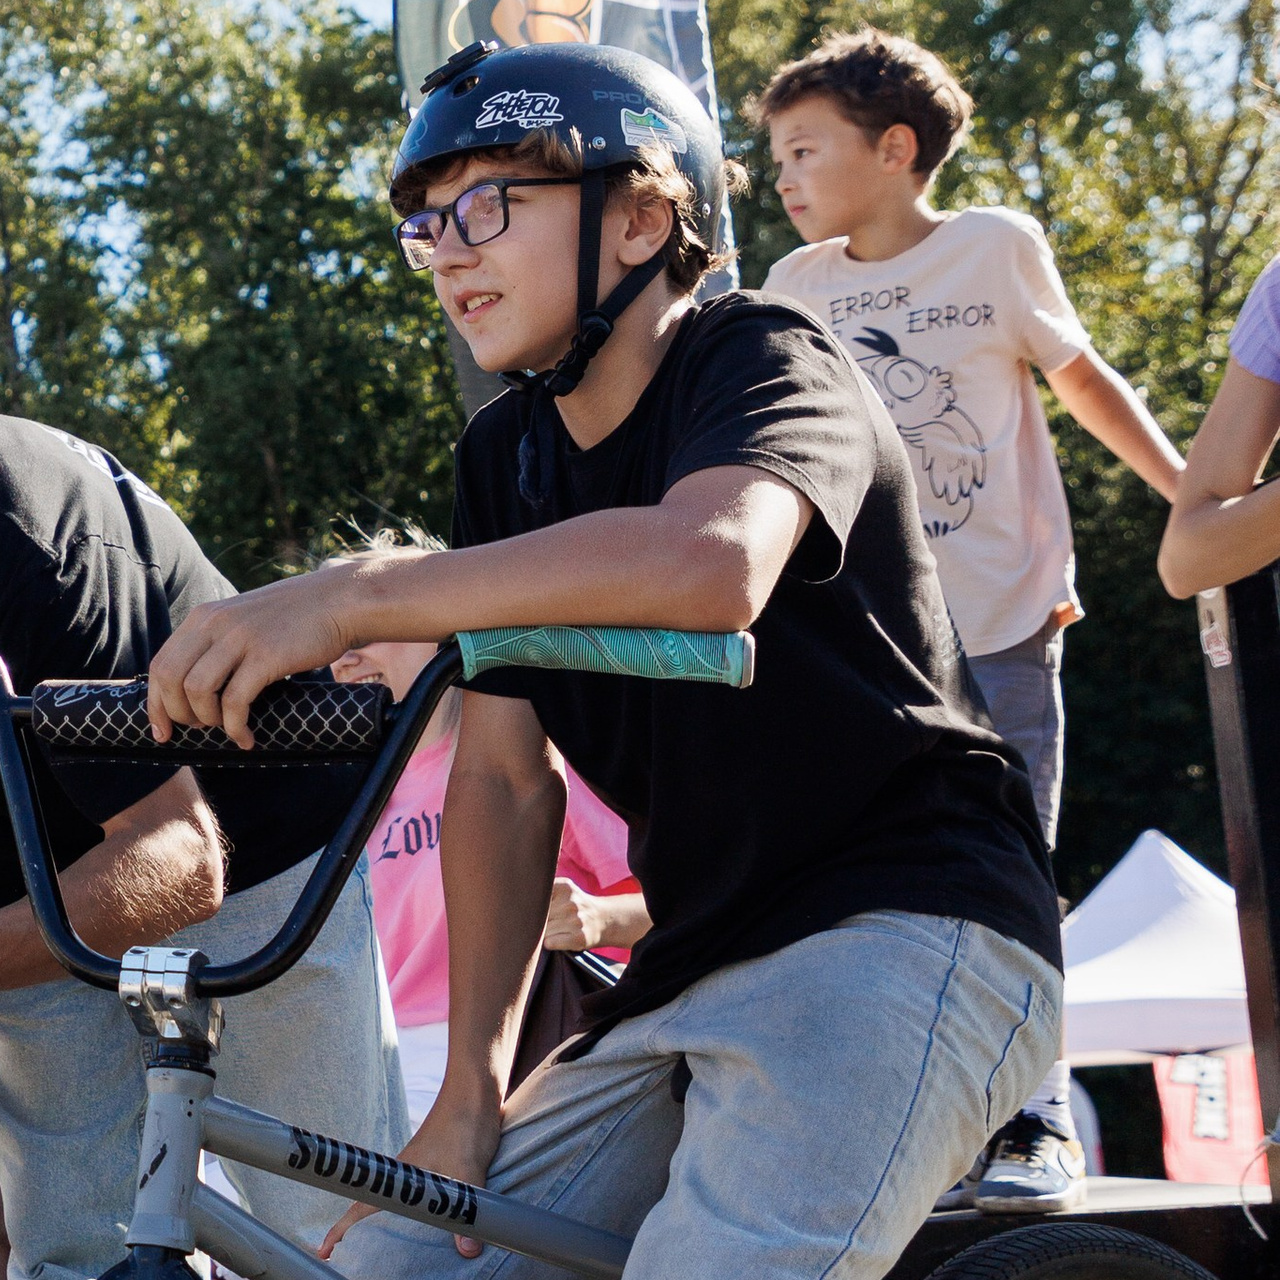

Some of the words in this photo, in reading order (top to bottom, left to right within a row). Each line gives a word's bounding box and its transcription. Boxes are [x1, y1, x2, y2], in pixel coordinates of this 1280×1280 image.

[591, 89, 648, 106] PRO
[829, 286, 911, 325] ERROR
[906, 302, 996, 333] ERROR
[374, 810, 441, 864] Lov
[288, 1125, 478, 1226] SUBROSA
